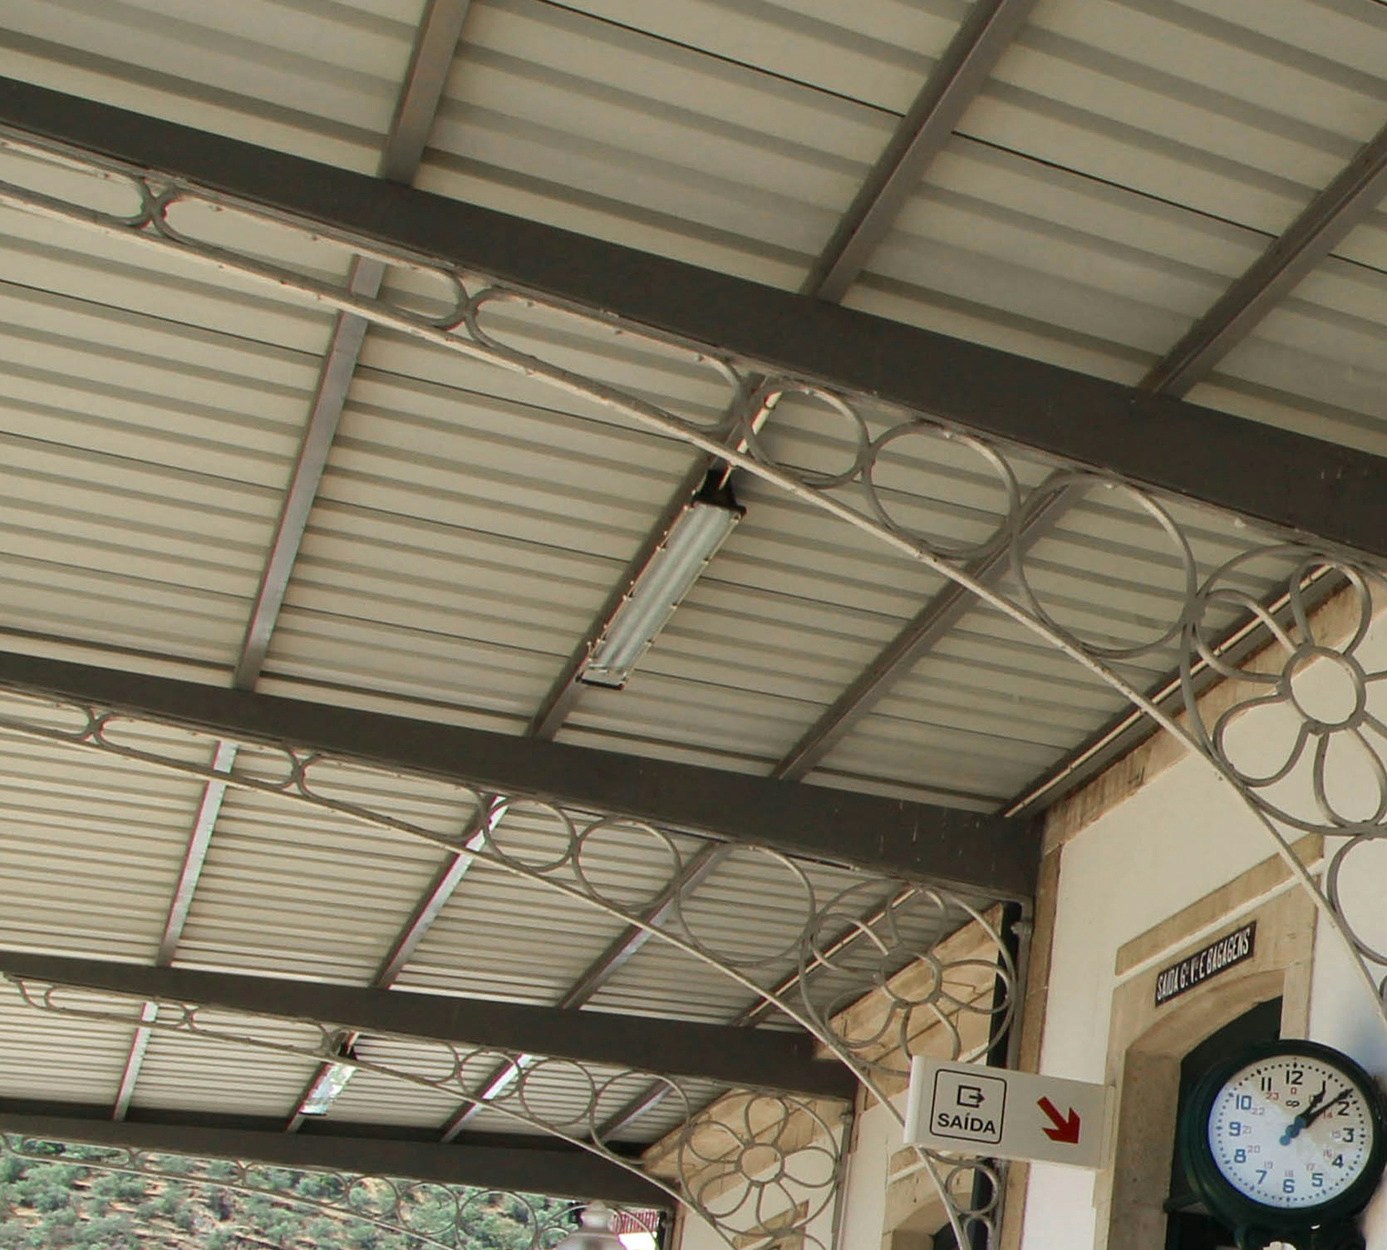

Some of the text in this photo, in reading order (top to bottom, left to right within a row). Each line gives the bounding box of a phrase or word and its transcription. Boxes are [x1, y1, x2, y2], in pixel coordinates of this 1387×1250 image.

[1261, 1077, 1272, 1092] 11
[1285, 1070, 1304, 1085] 12
[1235, 1094, 1252, 1110] 10
[1266, 1092, 1280, 1100] 23
[1338, 1101, 1350, 1116] 2
[937, 1112, 996, 1135] SAÍDA
[1229, 1122, 1241, 1137] 9
[1342, 1127, 1355, 1143] 3
[1234, 1149, 1247, 1164] 8
[1332, 1154, 1344, 1169] 4
[1255, 1170, 1268, 1185] 7
[1311, 1173, 1324, 1188] 5
[1283, 1179, 1295, 1194] 6
